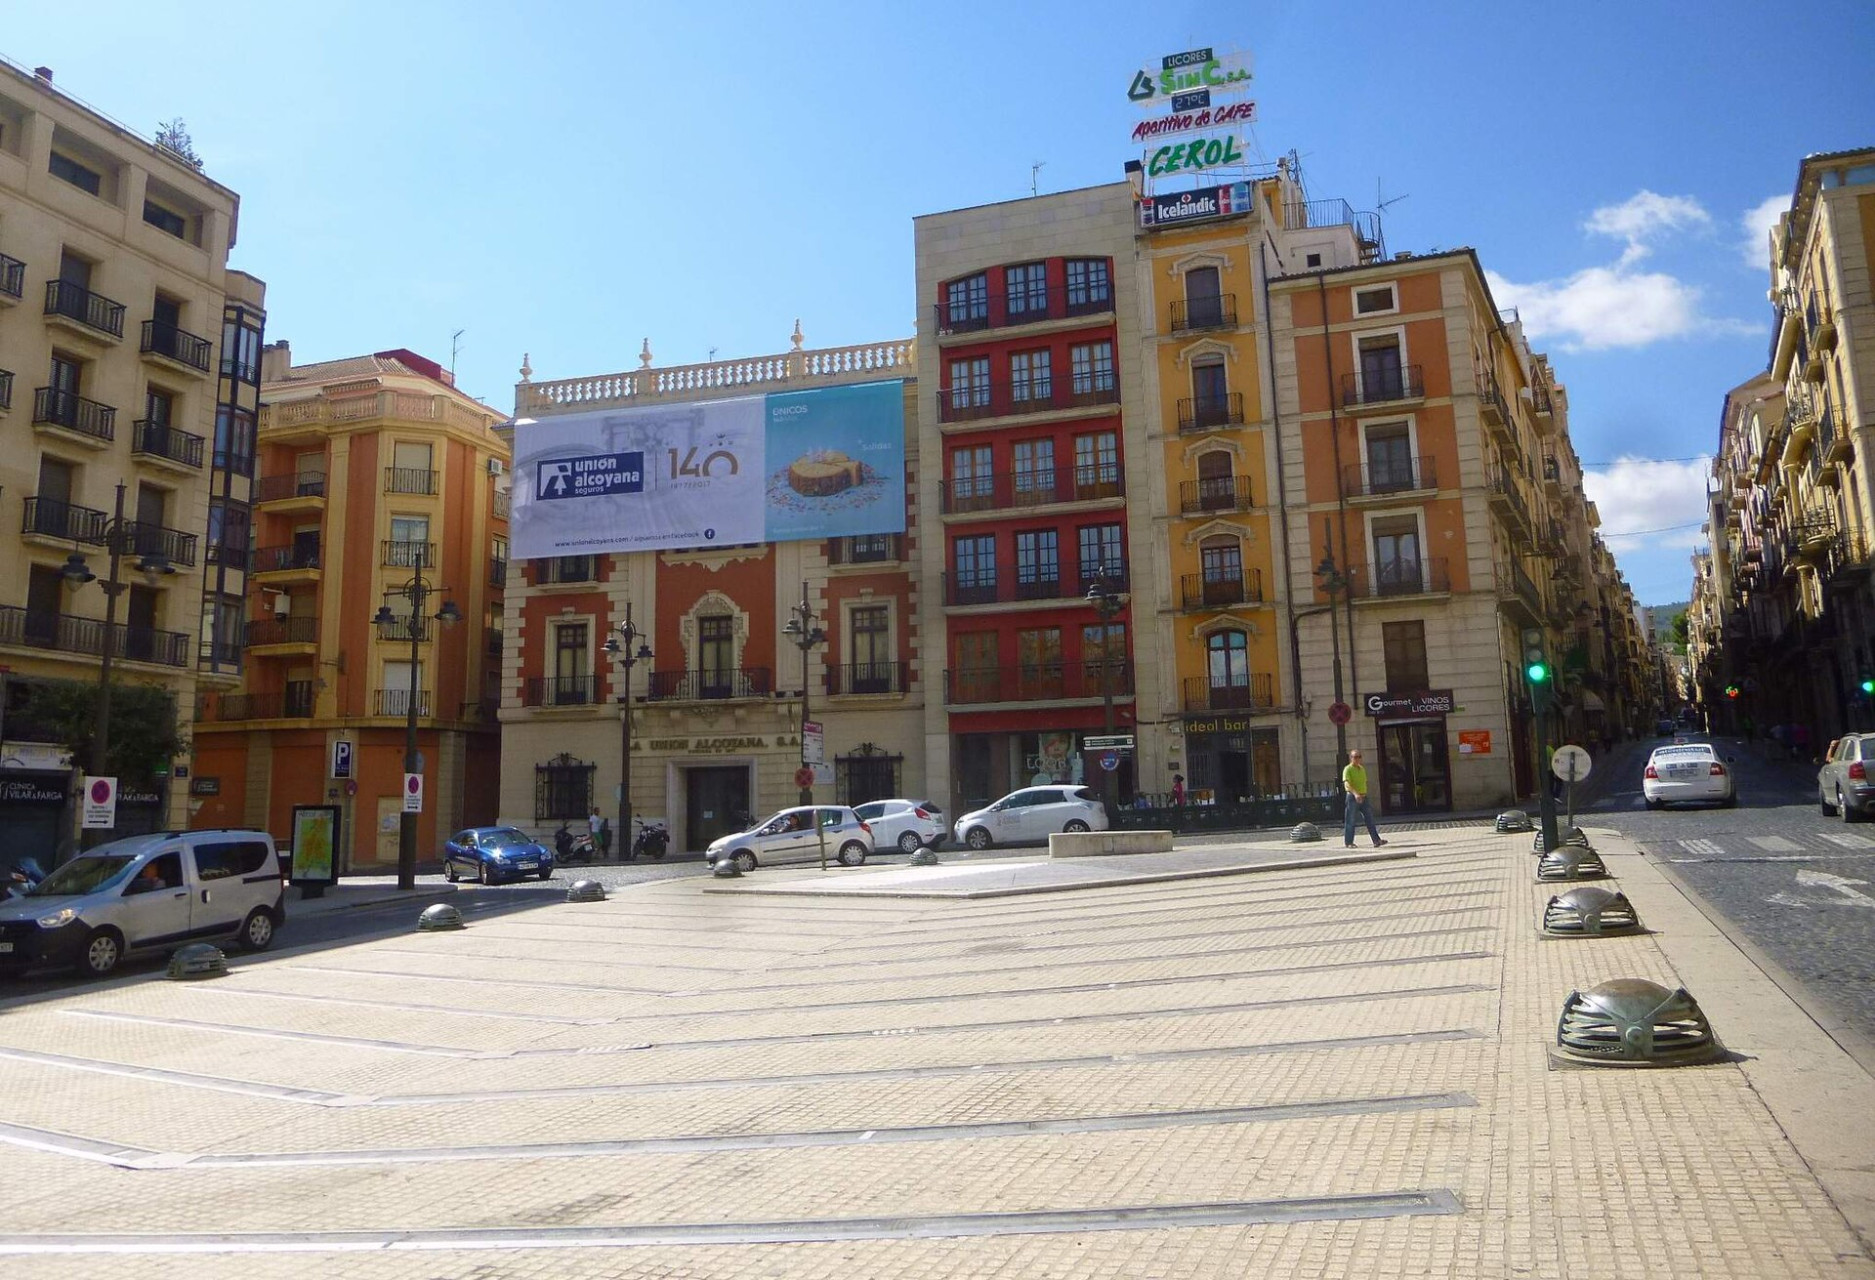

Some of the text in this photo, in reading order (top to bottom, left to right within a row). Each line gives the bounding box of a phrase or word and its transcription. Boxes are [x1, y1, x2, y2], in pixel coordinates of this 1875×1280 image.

[1168, 51, 1207, 66] LICORES
[1213, 103, 1255, 123] CAFE
[1148, 135, 1242, 177] CEROL
[1157, 196, 1216, 220] Icelandic
[575, 457, 617, 473] unión
[668, 446, 739, 480] 140
[575, 470, 640, 490] alcoyana
[575, 485, 605, 496] seguros
[1367, 695, 1450, 711] Gourmet VINOS
[1411, 703, 1450, 713] LICORES
[1185, 718, 1248, 732] ideal bar
[337, 743, 349, 764] P
